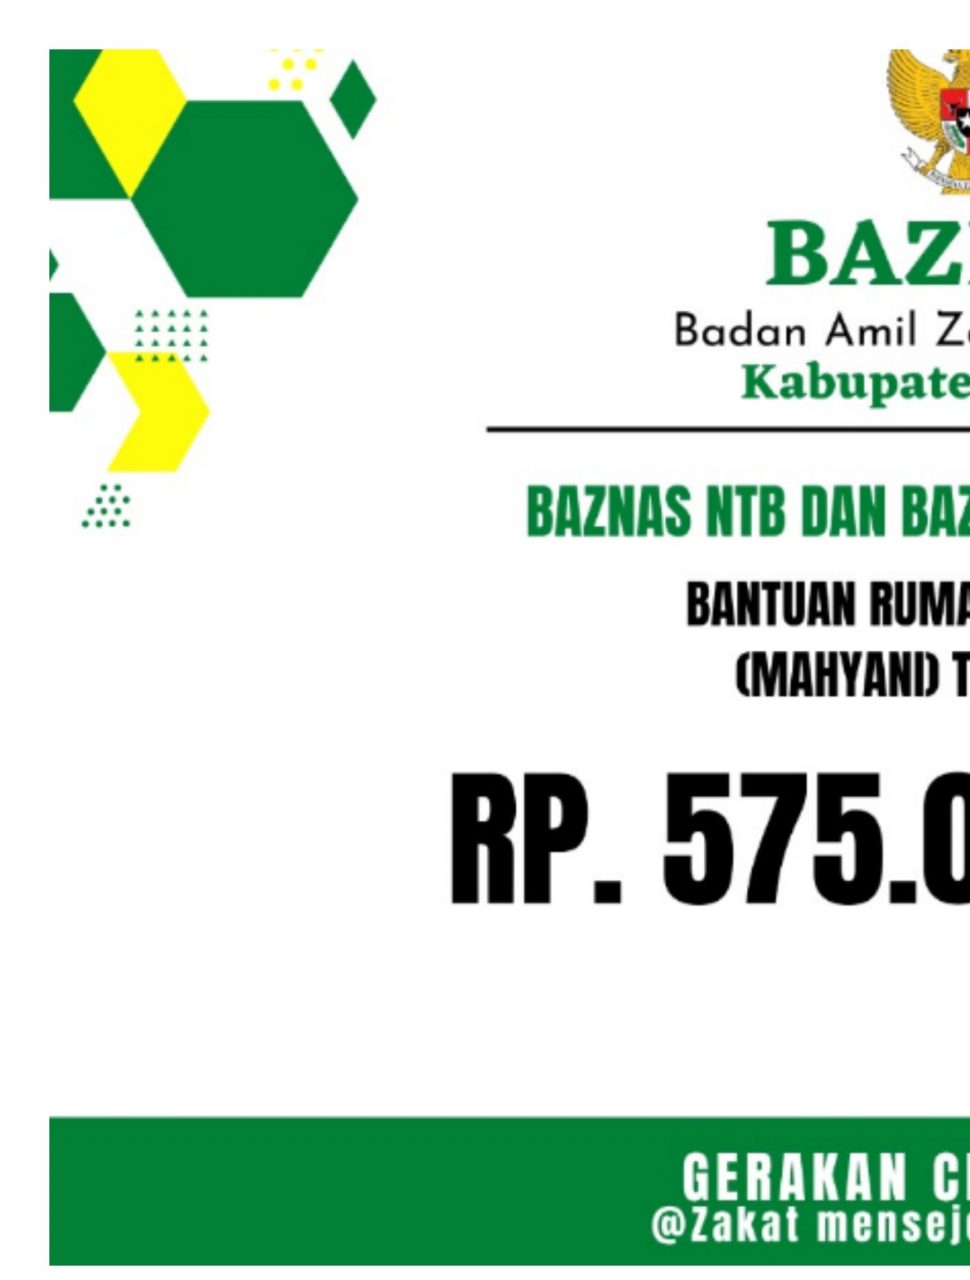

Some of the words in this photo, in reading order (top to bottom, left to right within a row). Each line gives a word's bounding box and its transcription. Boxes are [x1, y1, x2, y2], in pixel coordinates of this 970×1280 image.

[676, 309, 805, 347] Badan
[825, 309, 916, 347] Amil
[527, 484, 692, 537] BAZNAS
[706, 484, 786, 537] NTB
[802, 484, 886, 537] DAN
[687, 581, 856, 627] BANTUAN
[736, 651, 940, 697] (MAHYANI)
[451, 772, 622, 904] RP.
[683, 1152, 905, 1201] GERAKAN
[652, 1205, 798, 1244] @Zakat
